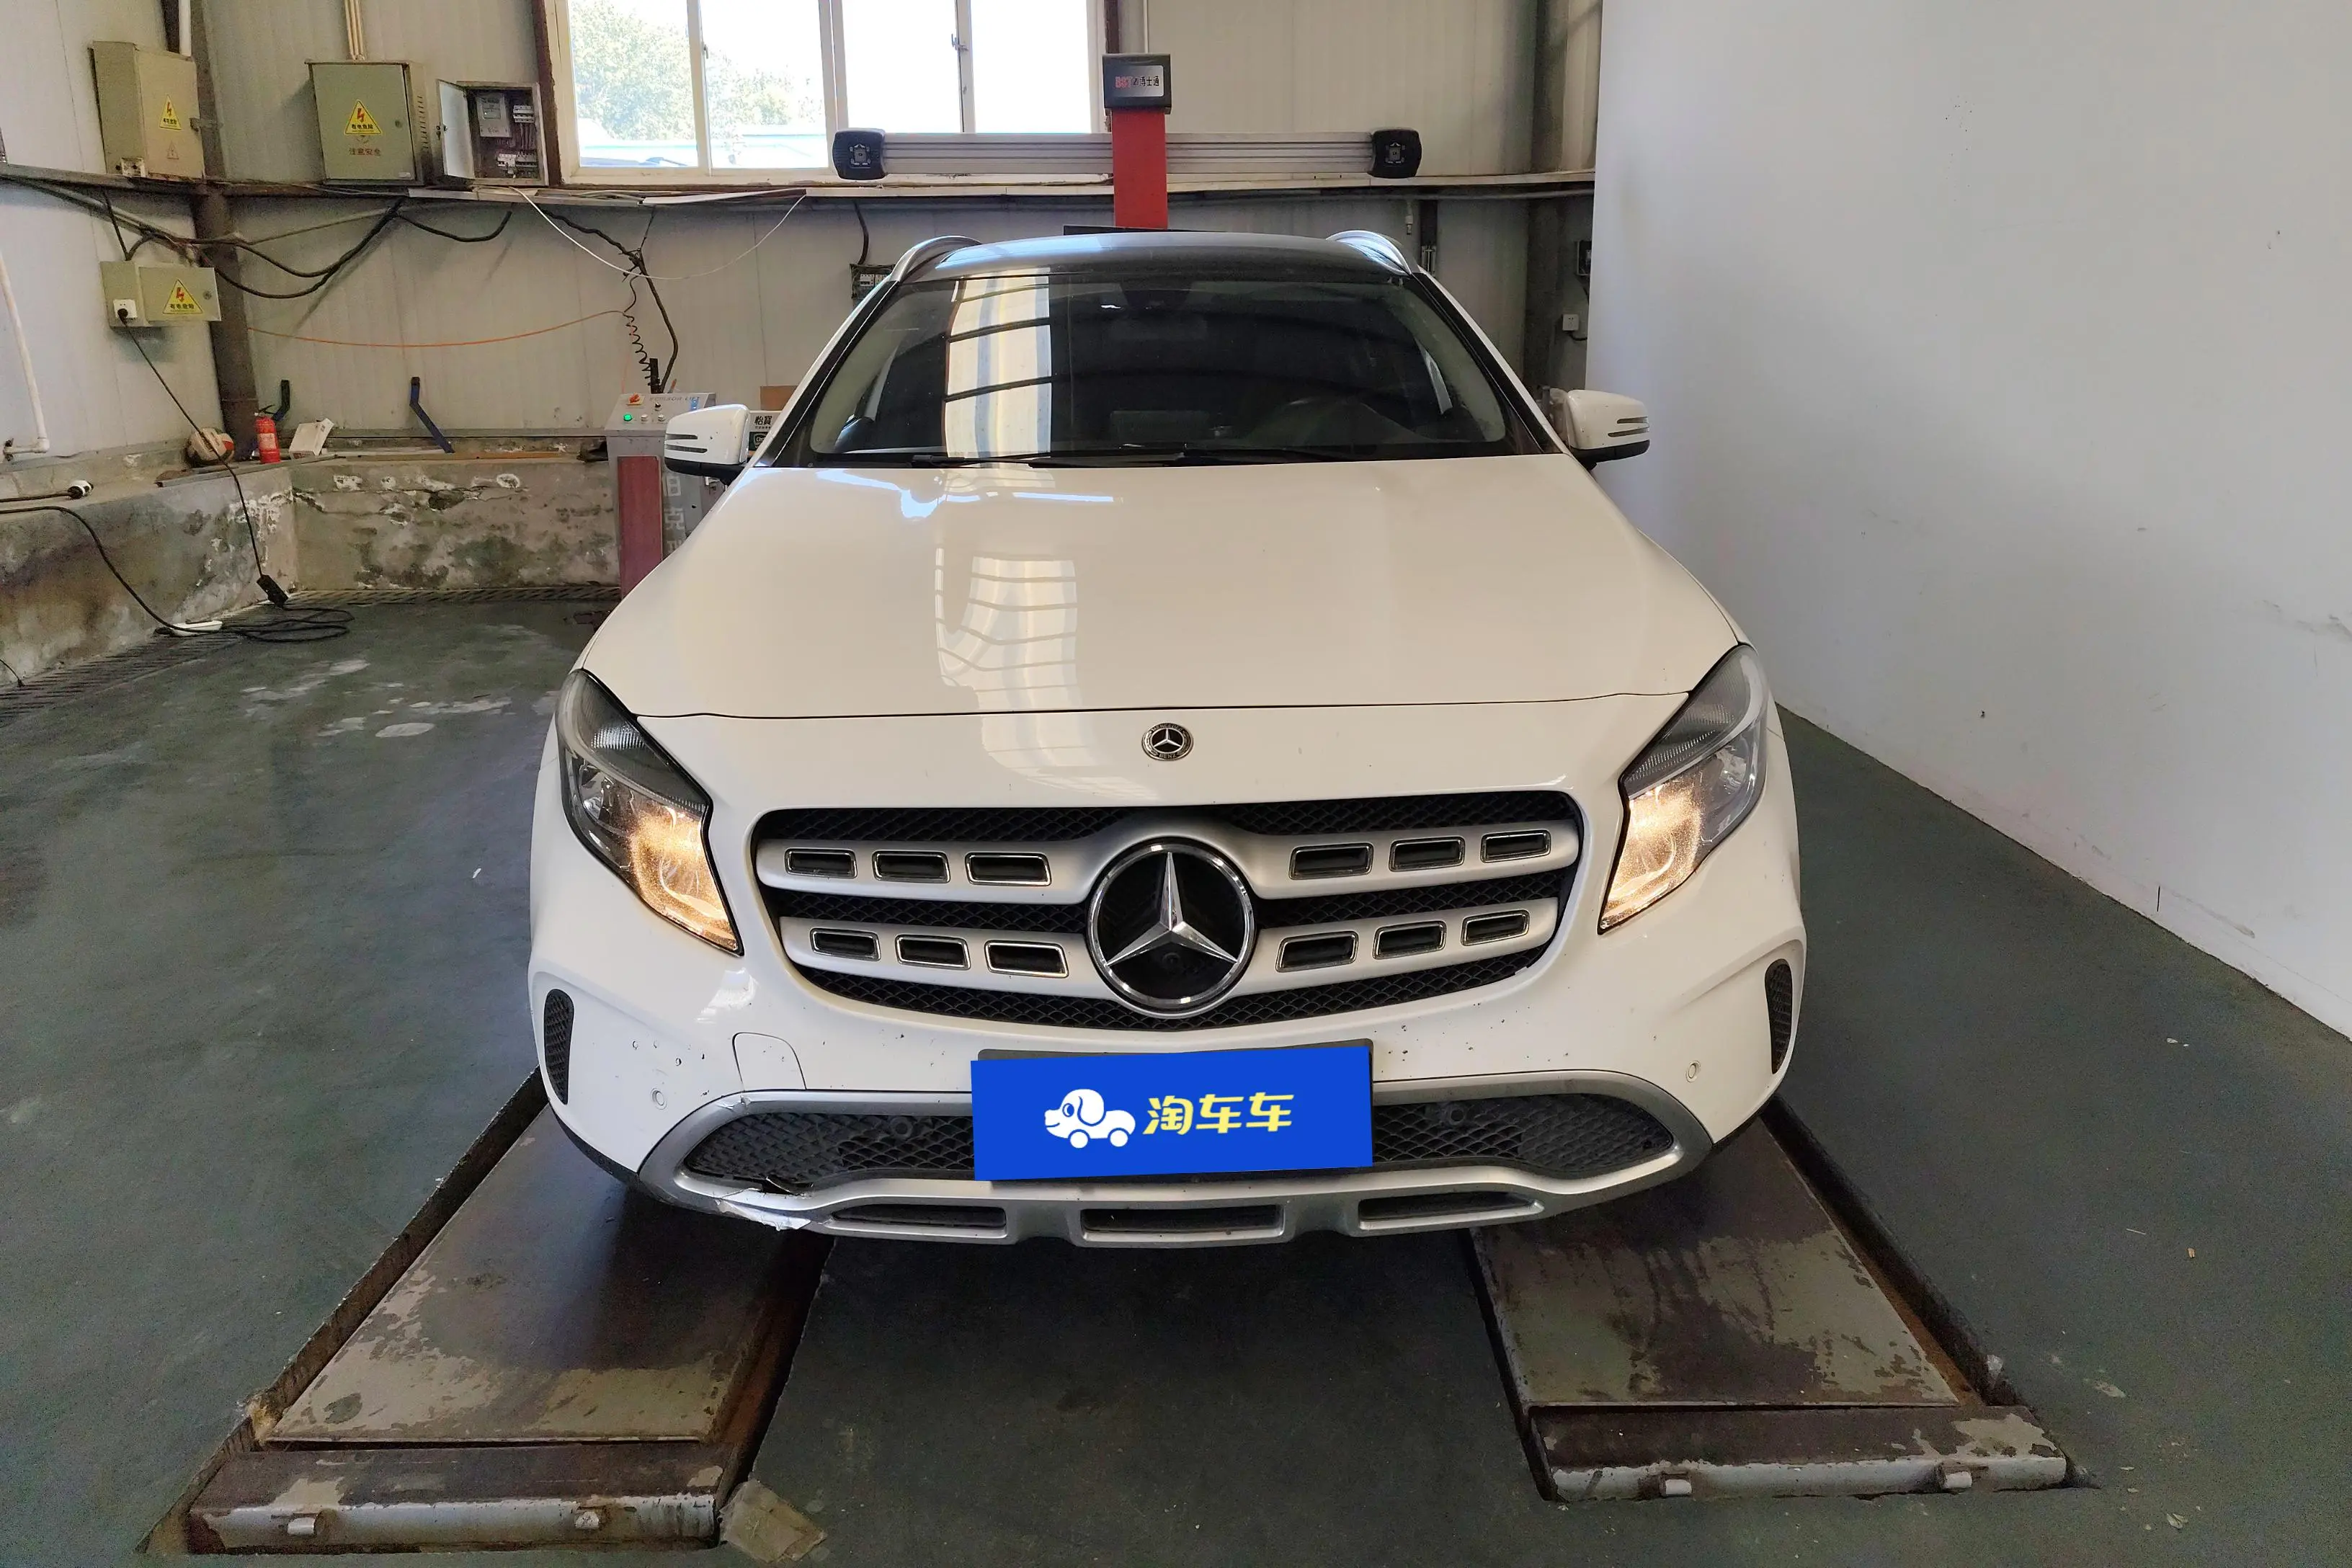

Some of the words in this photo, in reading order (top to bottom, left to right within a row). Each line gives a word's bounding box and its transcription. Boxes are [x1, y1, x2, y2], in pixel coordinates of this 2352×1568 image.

[1139, 76, 1159, 87] 博士通
[349, 148, 381, 156] 注意安全
[1152, 723, 1182, 732] MERCEDES
